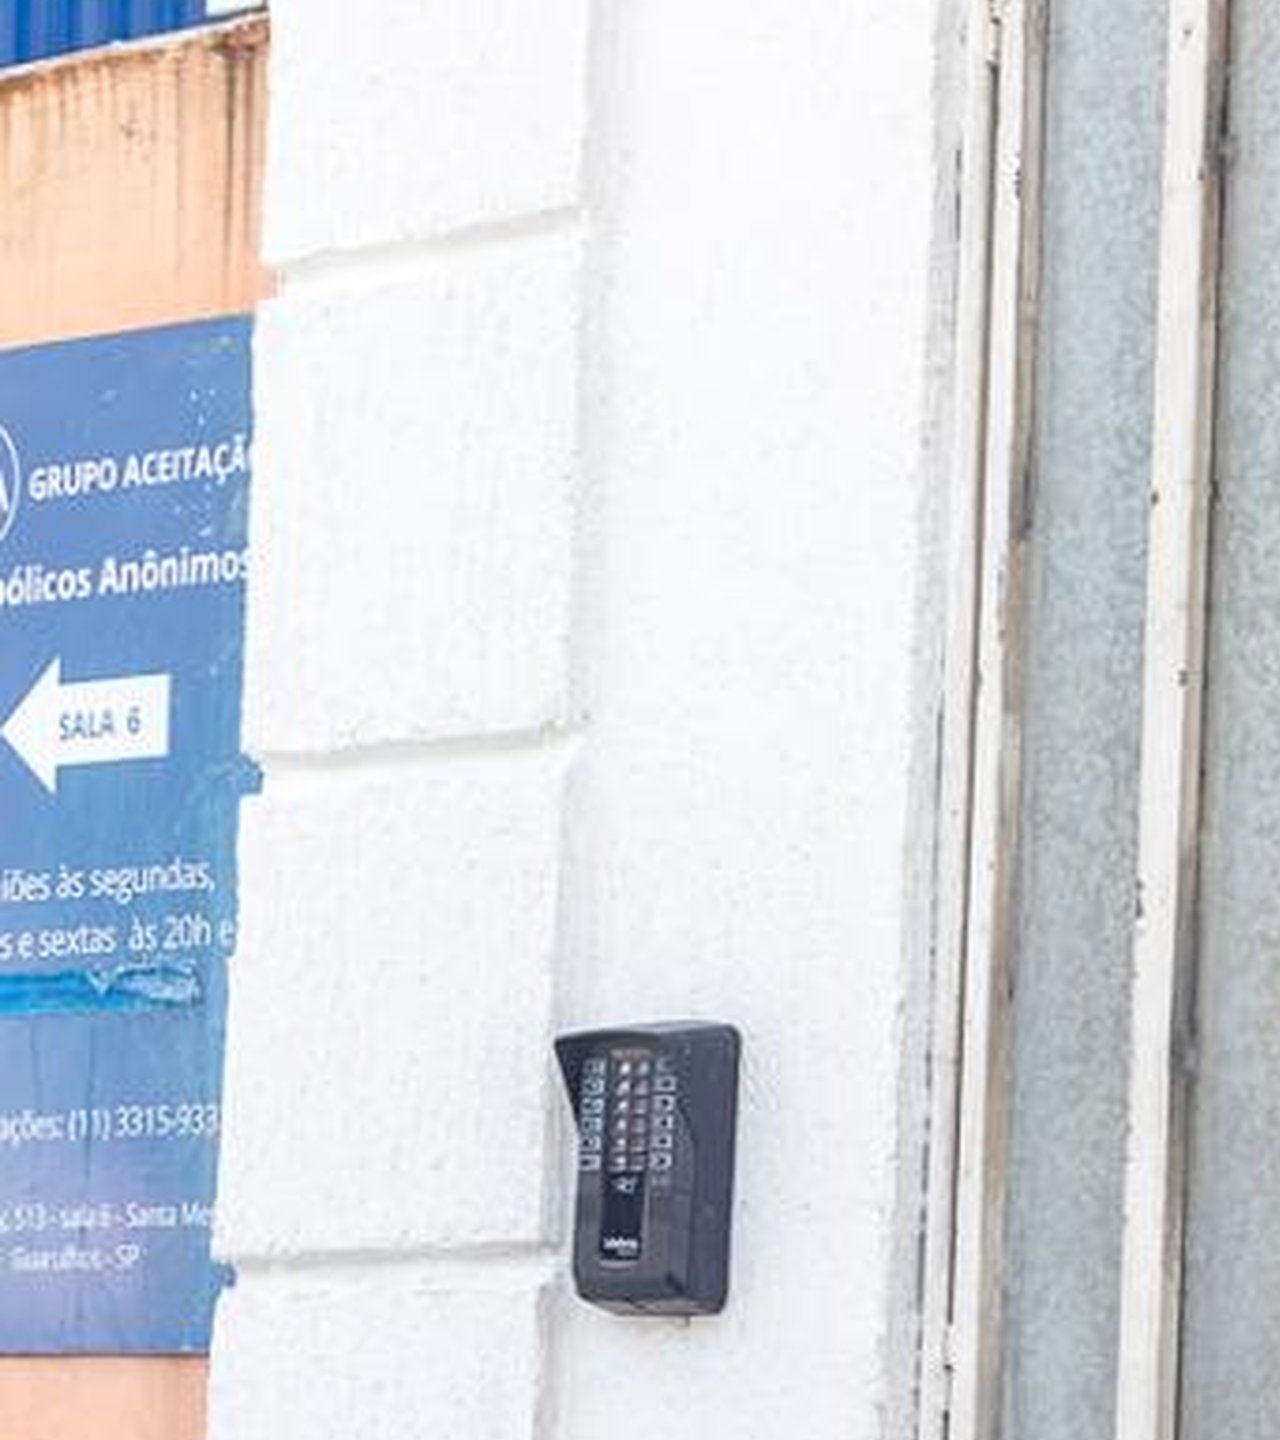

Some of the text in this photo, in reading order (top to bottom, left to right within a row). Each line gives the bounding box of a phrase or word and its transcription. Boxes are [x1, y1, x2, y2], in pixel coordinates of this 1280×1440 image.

[28, 458, 118, 501] GRUPO
[59, 706, 140, 741] SALA 6
[56, 864, 84, 898] às
[90, 857, 215, 904] segundas,
[18, 932, 33, 958] e
[39, 924, 117, 957] sextas
[129, 916, 158, 951] às
[163, 914, 212, 949] 20h
[68, 1108, 110, 1141] (11)
